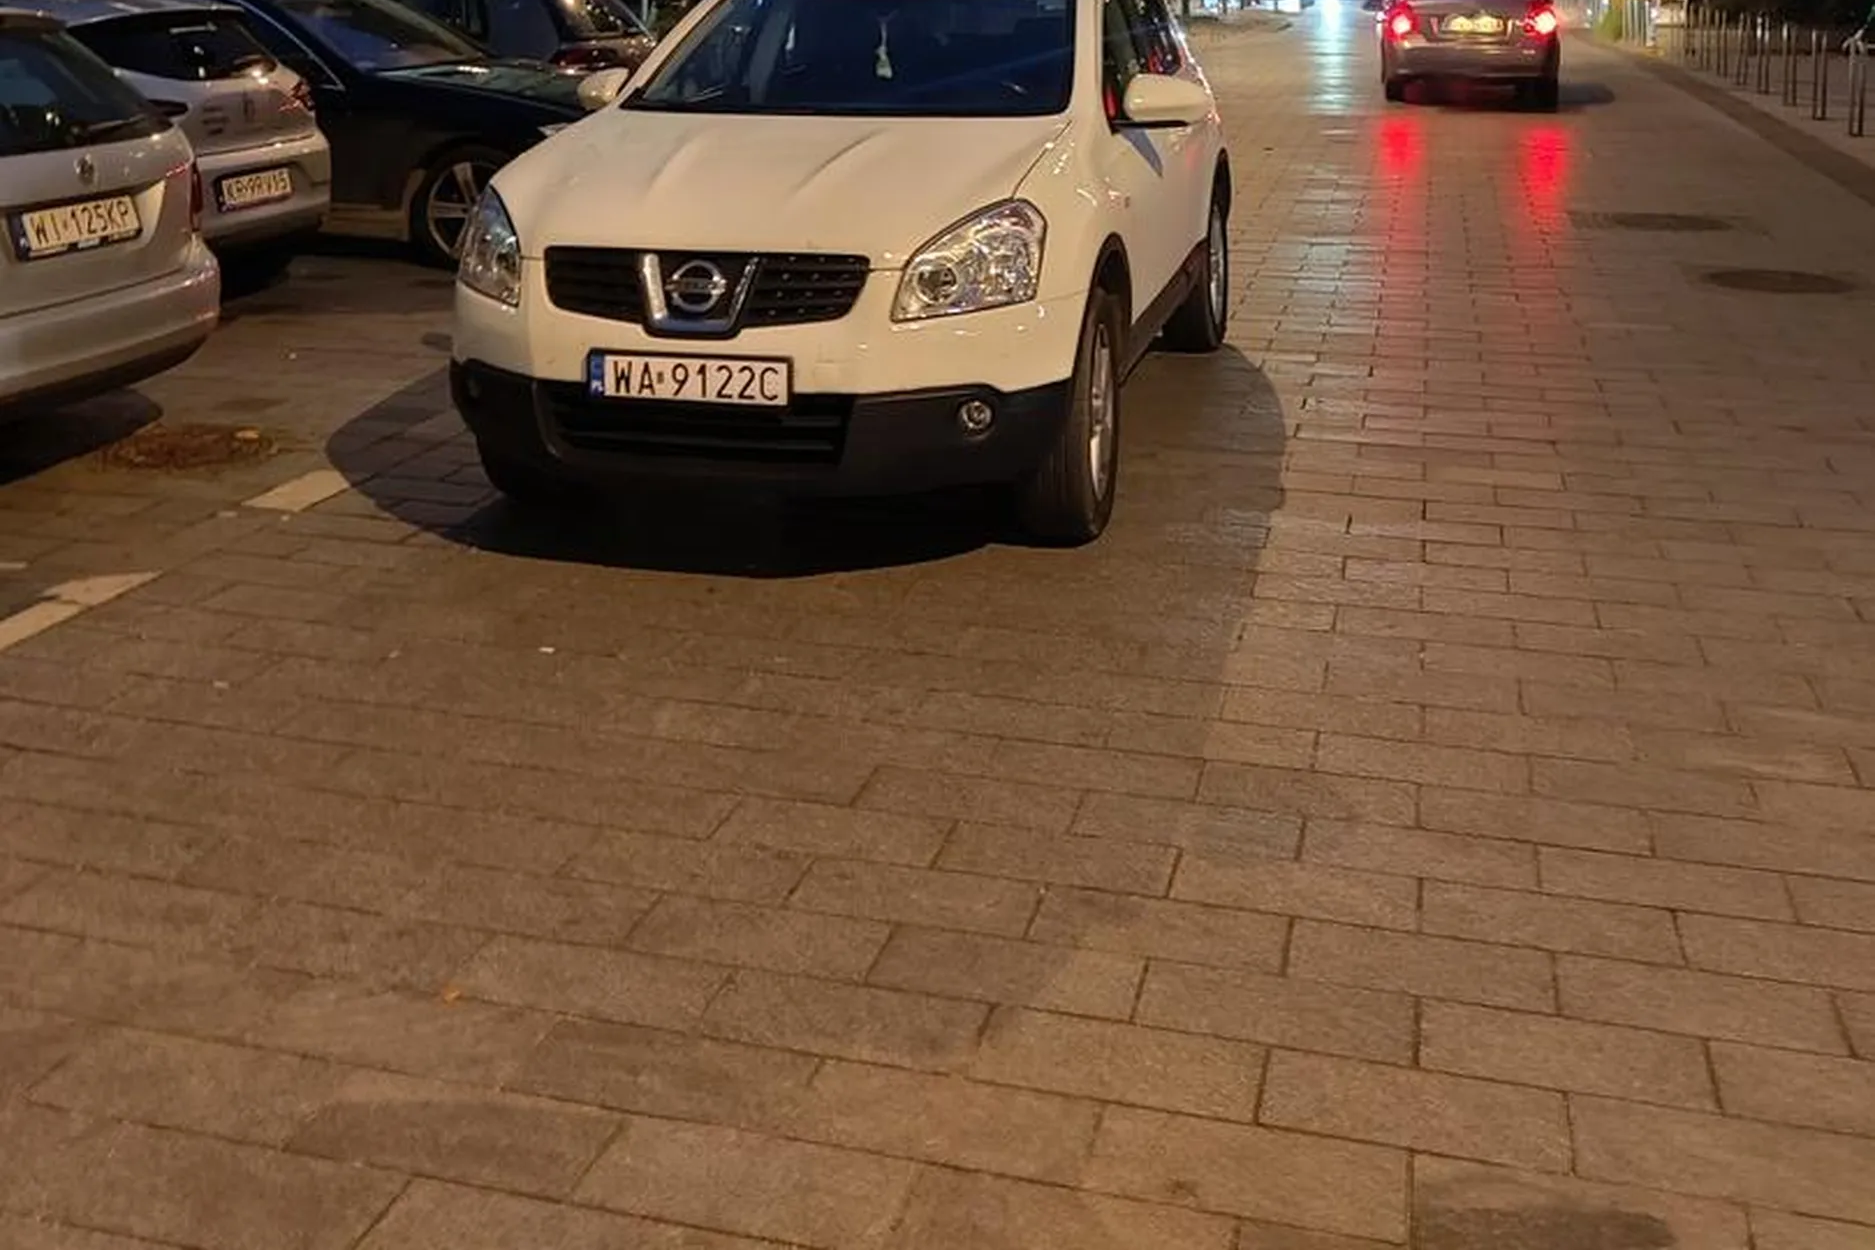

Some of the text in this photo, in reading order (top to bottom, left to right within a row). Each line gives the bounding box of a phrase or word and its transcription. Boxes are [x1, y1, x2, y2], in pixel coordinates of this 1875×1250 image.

[30, 200, 129, 245] WI 125KP
[613, 361, 779, 401] WA 9122C
